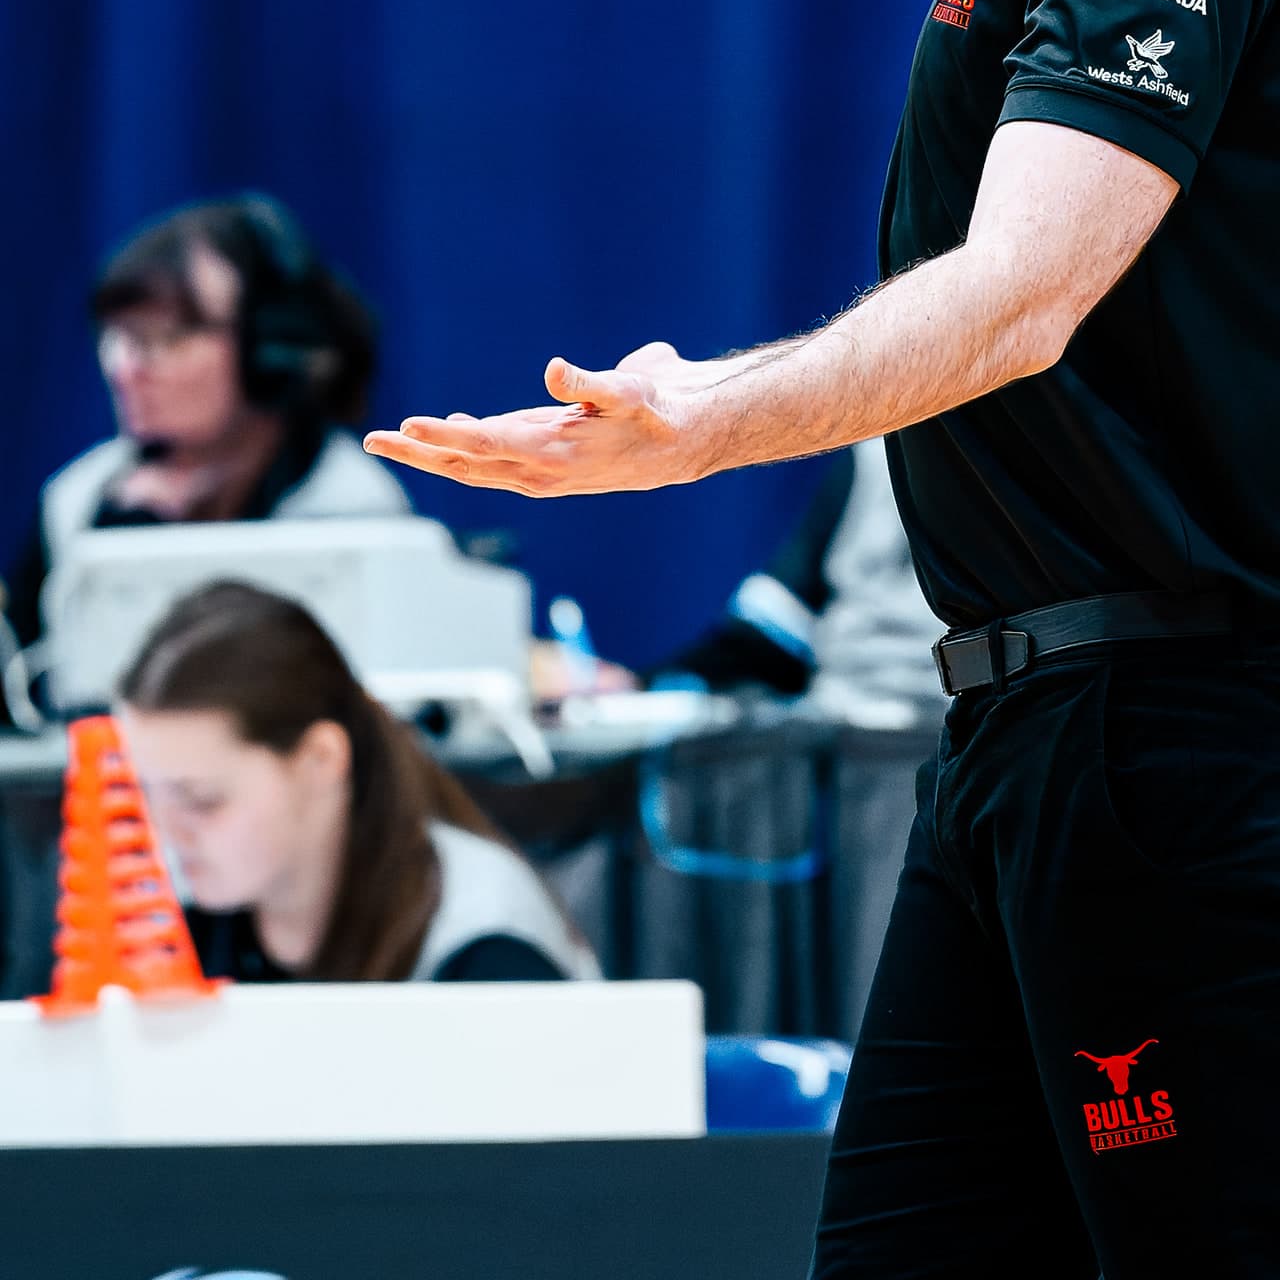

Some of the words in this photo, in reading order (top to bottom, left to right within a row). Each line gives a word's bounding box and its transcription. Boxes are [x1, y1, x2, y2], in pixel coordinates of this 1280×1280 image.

[1087, 65, 1133, 86] Wests
[1137, 75, 1190, 106] Ashfield
[1083, 1090, 1174, 1132] BULLS
